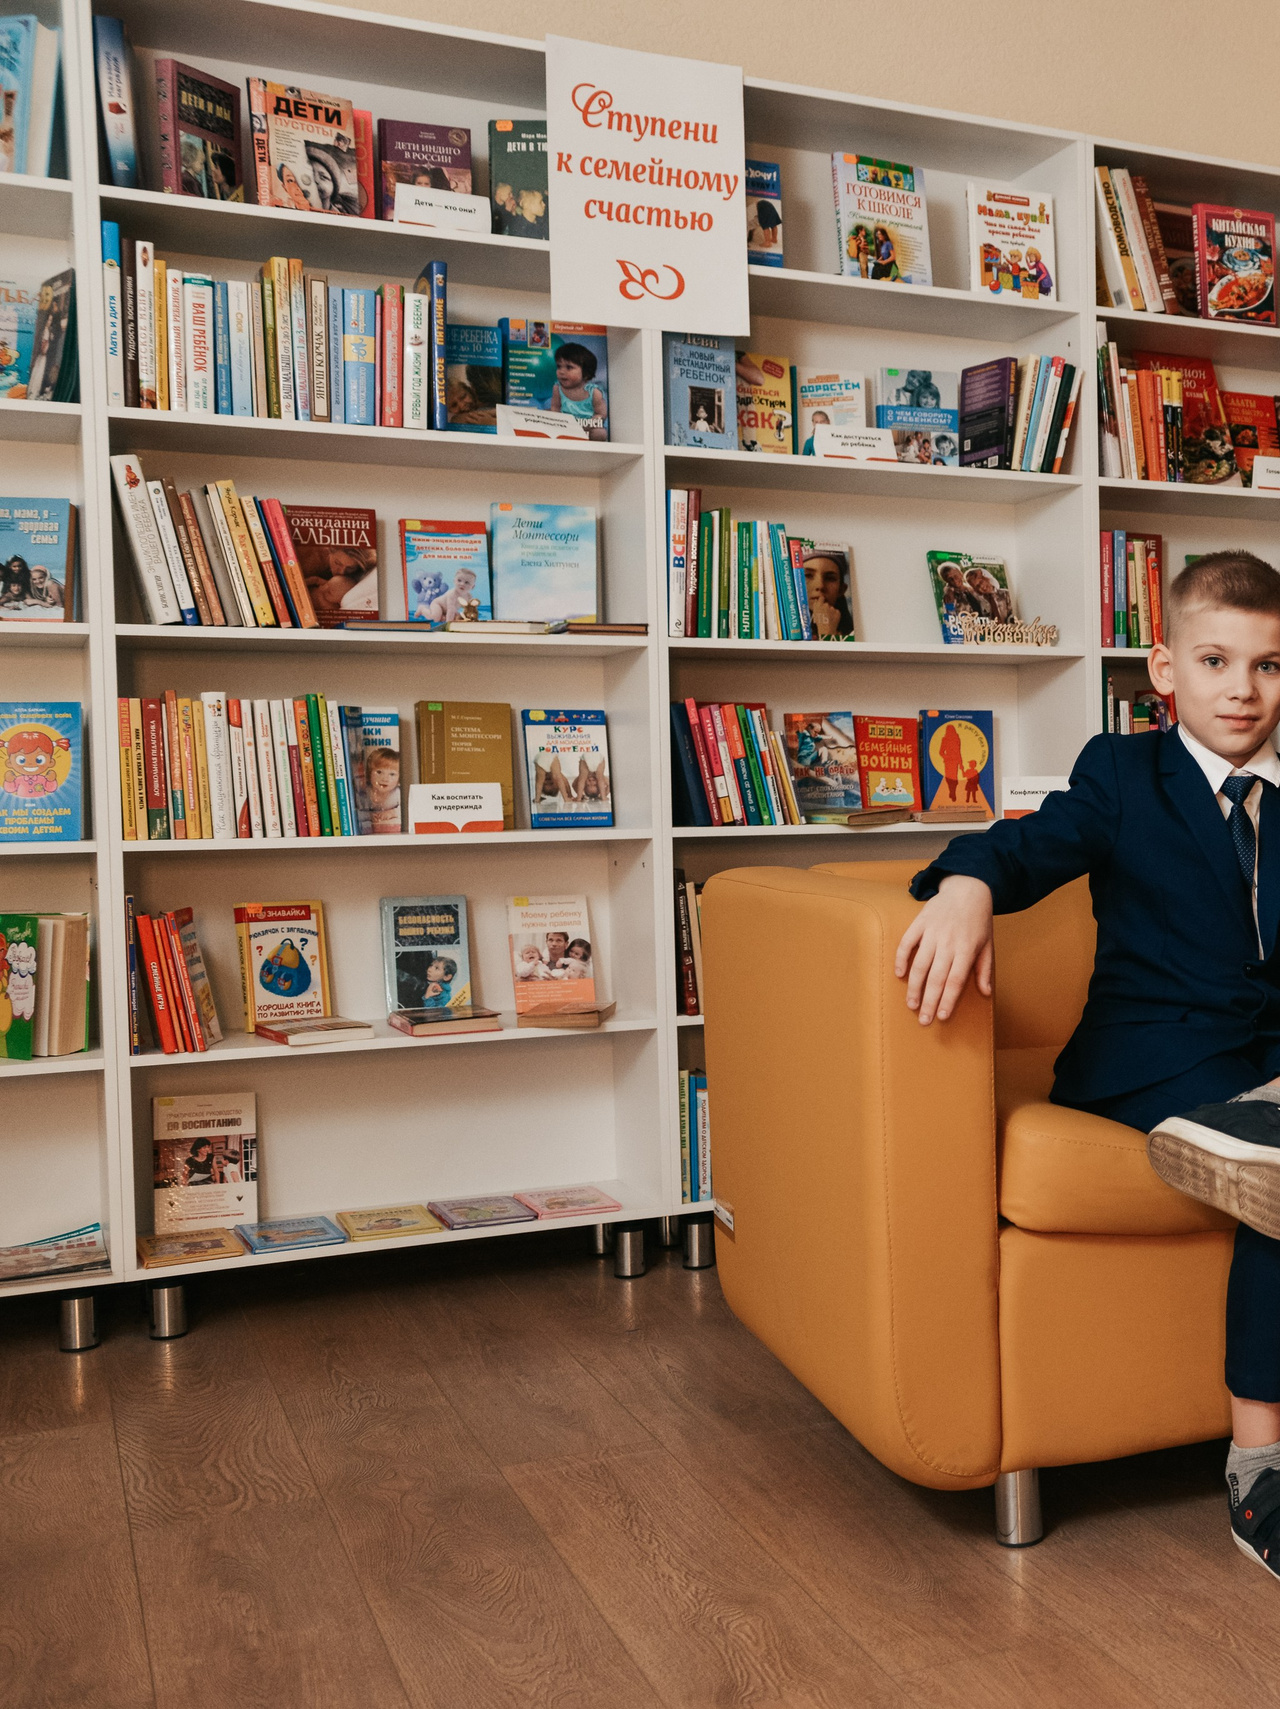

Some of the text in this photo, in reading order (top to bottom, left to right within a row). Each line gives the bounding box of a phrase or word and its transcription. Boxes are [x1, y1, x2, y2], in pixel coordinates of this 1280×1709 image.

[274, 96, 342, 126] ДЕТИ
[572, 83, 718, 144] Ступени
[274, 118, 333, 138] ПУСТОТЫ
[256, 138, 266, 162] ДЕТИ
[395, 141, 461, 155] ДЕТИ ИНДИГО
[507, 142, 527, 152] ДЕТИ
[412, 153, 452, 163] РОССИИ
[556, 152, 739, 201] к семейному
[415, 199, 434, 207] Дети
[846, 183, 921, 208] ГОТОВИМСЯ
[584, 200, 714, 233] счастью
[857, 198, 913, 219] К ШКОЛЕ
[978, 204, 1050, 225] Мама, купи!
[1102, 182, 1129, 257] ДОМОВОДСТВО
[1212, 219, 1266, 237] КИТАЙСКАЯ
[1225, 234, 1255, 249] КУХНЯ
[108, 295, 118, 318] дитя
[126, 276, 136, 360] Мудрость воспитания
[138, 289, 148, 375] ДЕТСКОЕ МЕНЮ
[192, 303, 209, 371] ВАШ РЕБЁНОК
[460, 329, 498, 344] РЕБЕНКА
[109, 331, 118, 356] Мать
[172, 287, 183, 399] НОВОРОЖДЕННЫЙ РЕБЕНОК
[681, 333, 719, 349] Леви
[410, 299, 422, 420] ПЕРВЫЙ ГОД ЖИЗНИ РЕБЕНКА
[436, 298, 446, 405] ДЕТСКОЕ ПИТАНИЕ
[689, 350, 715, 362] НОВЫЙ
[315, 331, 325, 400] ЯНУШ КОРЧАК
[673, 357, 731, 373] НЕСТАНДАРТНЫЙ
[680, 369, 725, 384] РЕБЕНОК
[896, 416, 951, 424] РЕБЕНКОМ?
[913, 411, 953, 419] ГОВОРИТЬ
[14, 510, 40, 520] мама,
[224, 487, 240, 528] Януш Корчак
[19, 522, 59, 534] здоровая
[139, 499, 163, 564] ВАШЕГО РЕБЕНКА
[245, 500, 255, 518] ДЕТИ
[254, 532, 268, 558] ДЕНЬГИ
[291, 517, 370, 530] ожидании
[512, 518, 543, 529] Дети
[31, 535, 58, 544] семья
[128, 491, 156, 573] ЭНЦИКЛОПЕДИЯ ИМЕН
[512, 530, 579, 544] Монтессори
[672, 534, 685, 568] ВСЁ
[544, 560, 579, 569] Хилтунен
[689, 561, 697, 595] Мудрость
[154, 575, 169, 608] БОРИС ХИГИР
[742, 610, 750, 632] НЛП
[322, 712, 330, 746] МОТОРИКУ
[869, 727, 902, 737] ЛЕВИ
[539, 744, 599, 753] РОДИТЕЛЕЙ
[859, 741, 913, 754] СЕМЕЙНЫЕ
[861, 754, 913, 770] ВОЙНЫ
[151, 757, 160, 796] ДОШКОЛЬНАЯ
[794, 766, 855, 776] КАК НЕ ОРАТЬ
[329, 775, 337, 813] РАЗВИВАЕМ
[32, 808, 71, 816] СОЗДАЕМ
[434, 804, 483, 812] вундеркинда
[33, 826, 62, 834] ДЕТЯМ
[398, 915, 454, 924] БЕЗОПАСНОСТЬ
[521, 910, 582, 919] Моему ребенку
[522, 919, 582, 928] нужны правила
[249, 927, 280, 940] РЮКЗАЧОК
[286, 926, 318, 938] ЗАГАДКАМИ
[150, 961, 165, 1010] СЕМЕЙНЫЕ ИГРЫ
[257, 1002, 295, 1012] ХОРОШАЯ
[270, 1010, 305, 1018] РАЗВИТИЮ
[167, 1109, 242, 1119] ПРАКТИЧЕСКОЕ РУКОВОДСТВО
[167, 1117, 242, 1131] ПО ВОСПИТАНИЮ
